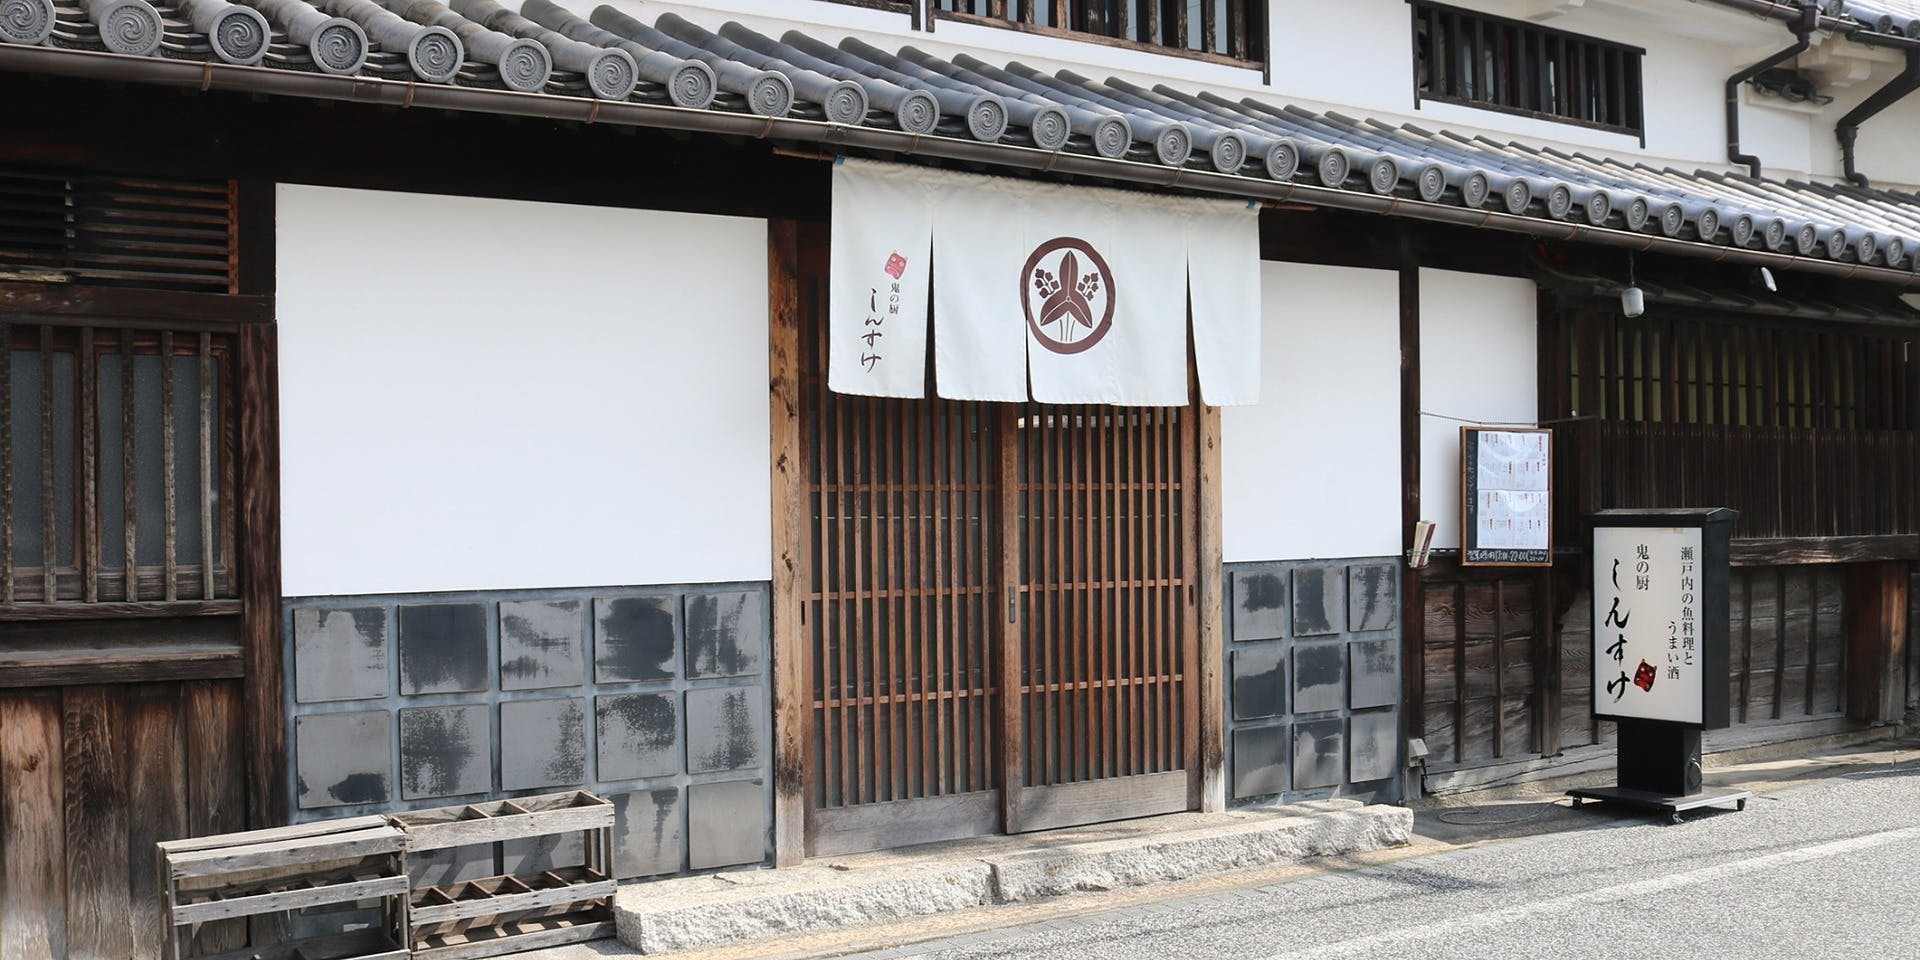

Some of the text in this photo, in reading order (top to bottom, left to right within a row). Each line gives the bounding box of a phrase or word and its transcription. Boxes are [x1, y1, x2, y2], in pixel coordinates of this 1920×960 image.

[861, 288, 884, 373] しんすけ
[1636, 543, 1650, 590] 鬼の厨
[1680, 546, 1695, 666] 瀬戸内の魚料理と
[1605, 558, 1631, 703] しんすけ
[1667, 621, 1680, 680] うまい酒
